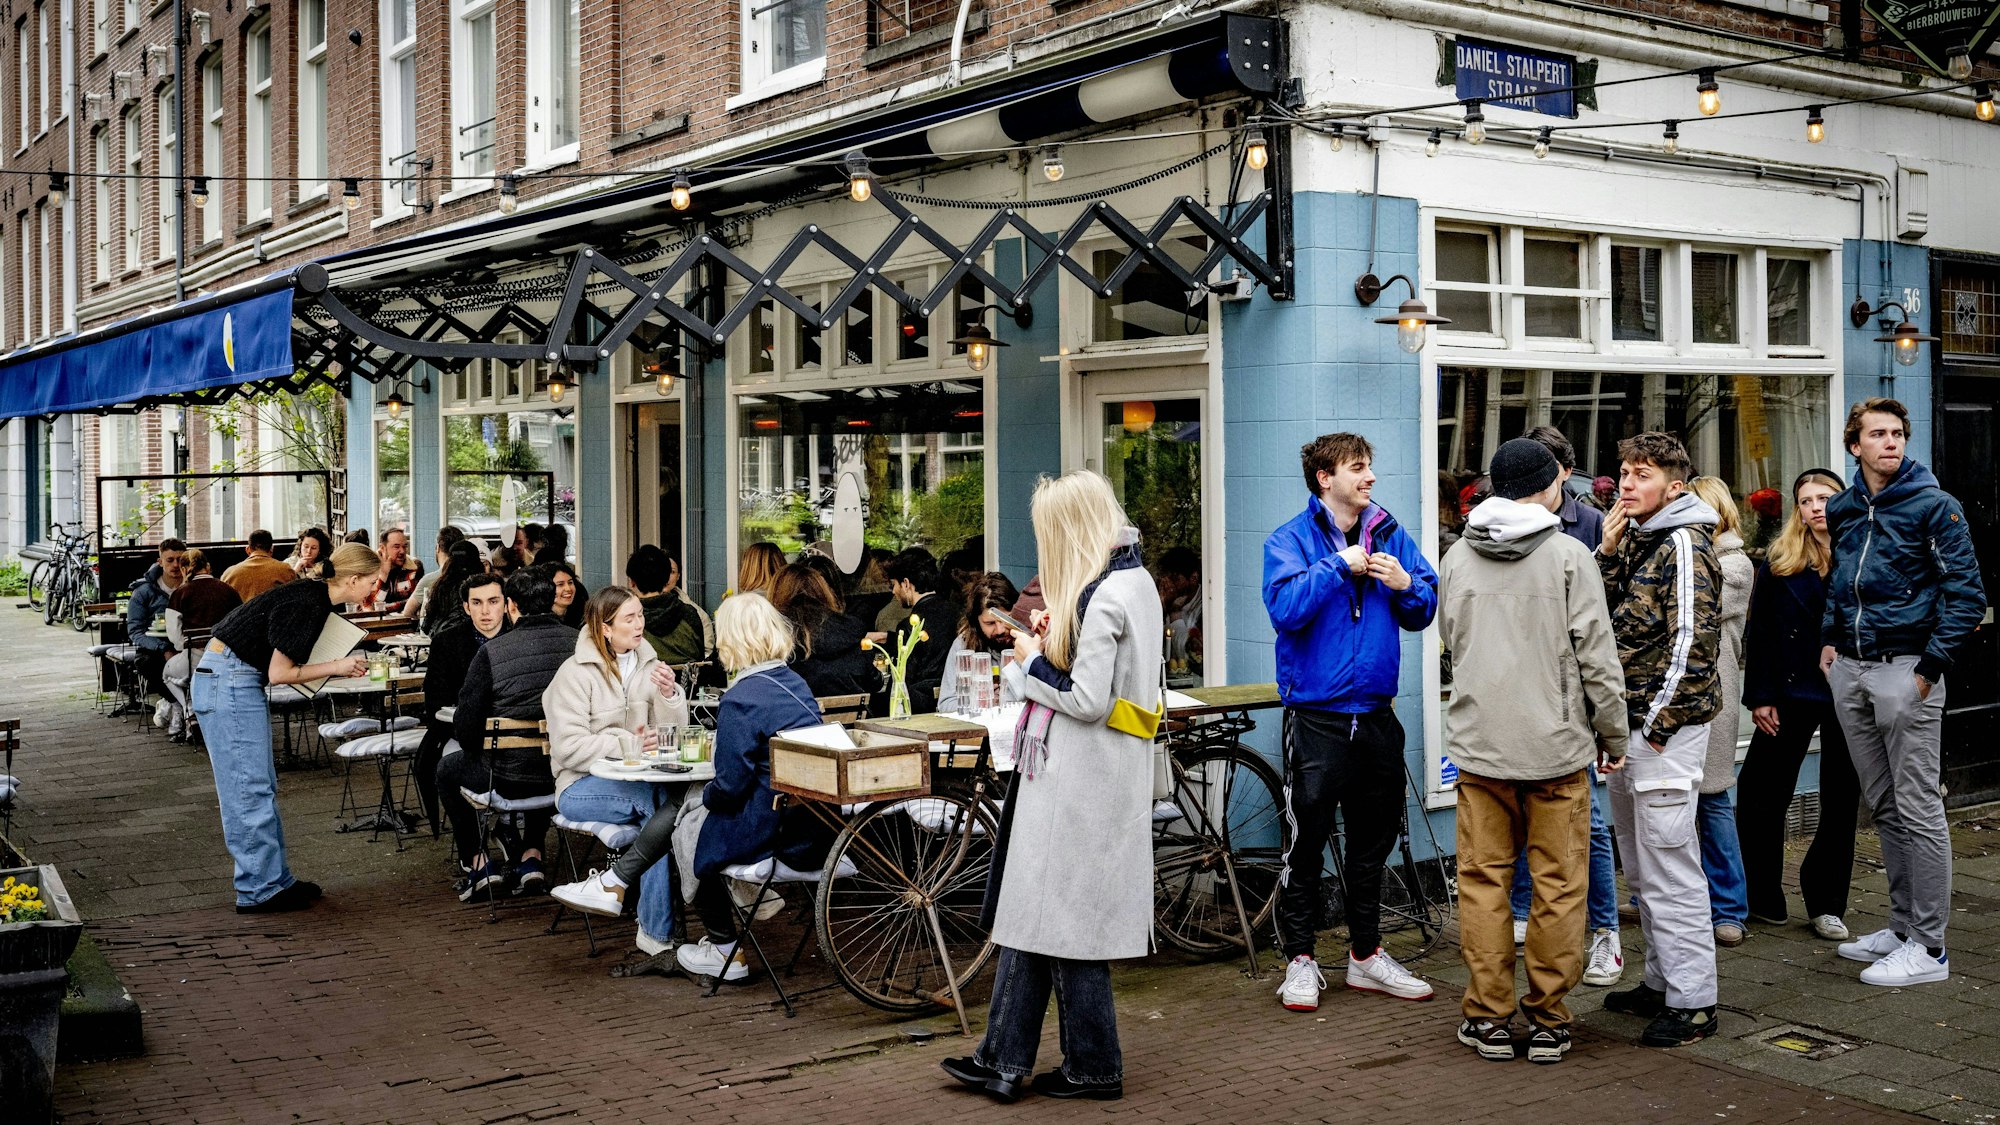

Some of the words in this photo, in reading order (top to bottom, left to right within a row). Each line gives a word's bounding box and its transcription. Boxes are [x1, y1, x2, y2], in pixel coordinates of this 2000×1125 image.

[1907, 7, 1981, 31] BIERBROUWERIJ
[1456, 45, 1501, 74] DANIEL
[1506, 55, 1566, 85] STALPERT
[1488, 79, 1538, 108] STRAAT
[1903, 287, 1921, 313] 36
